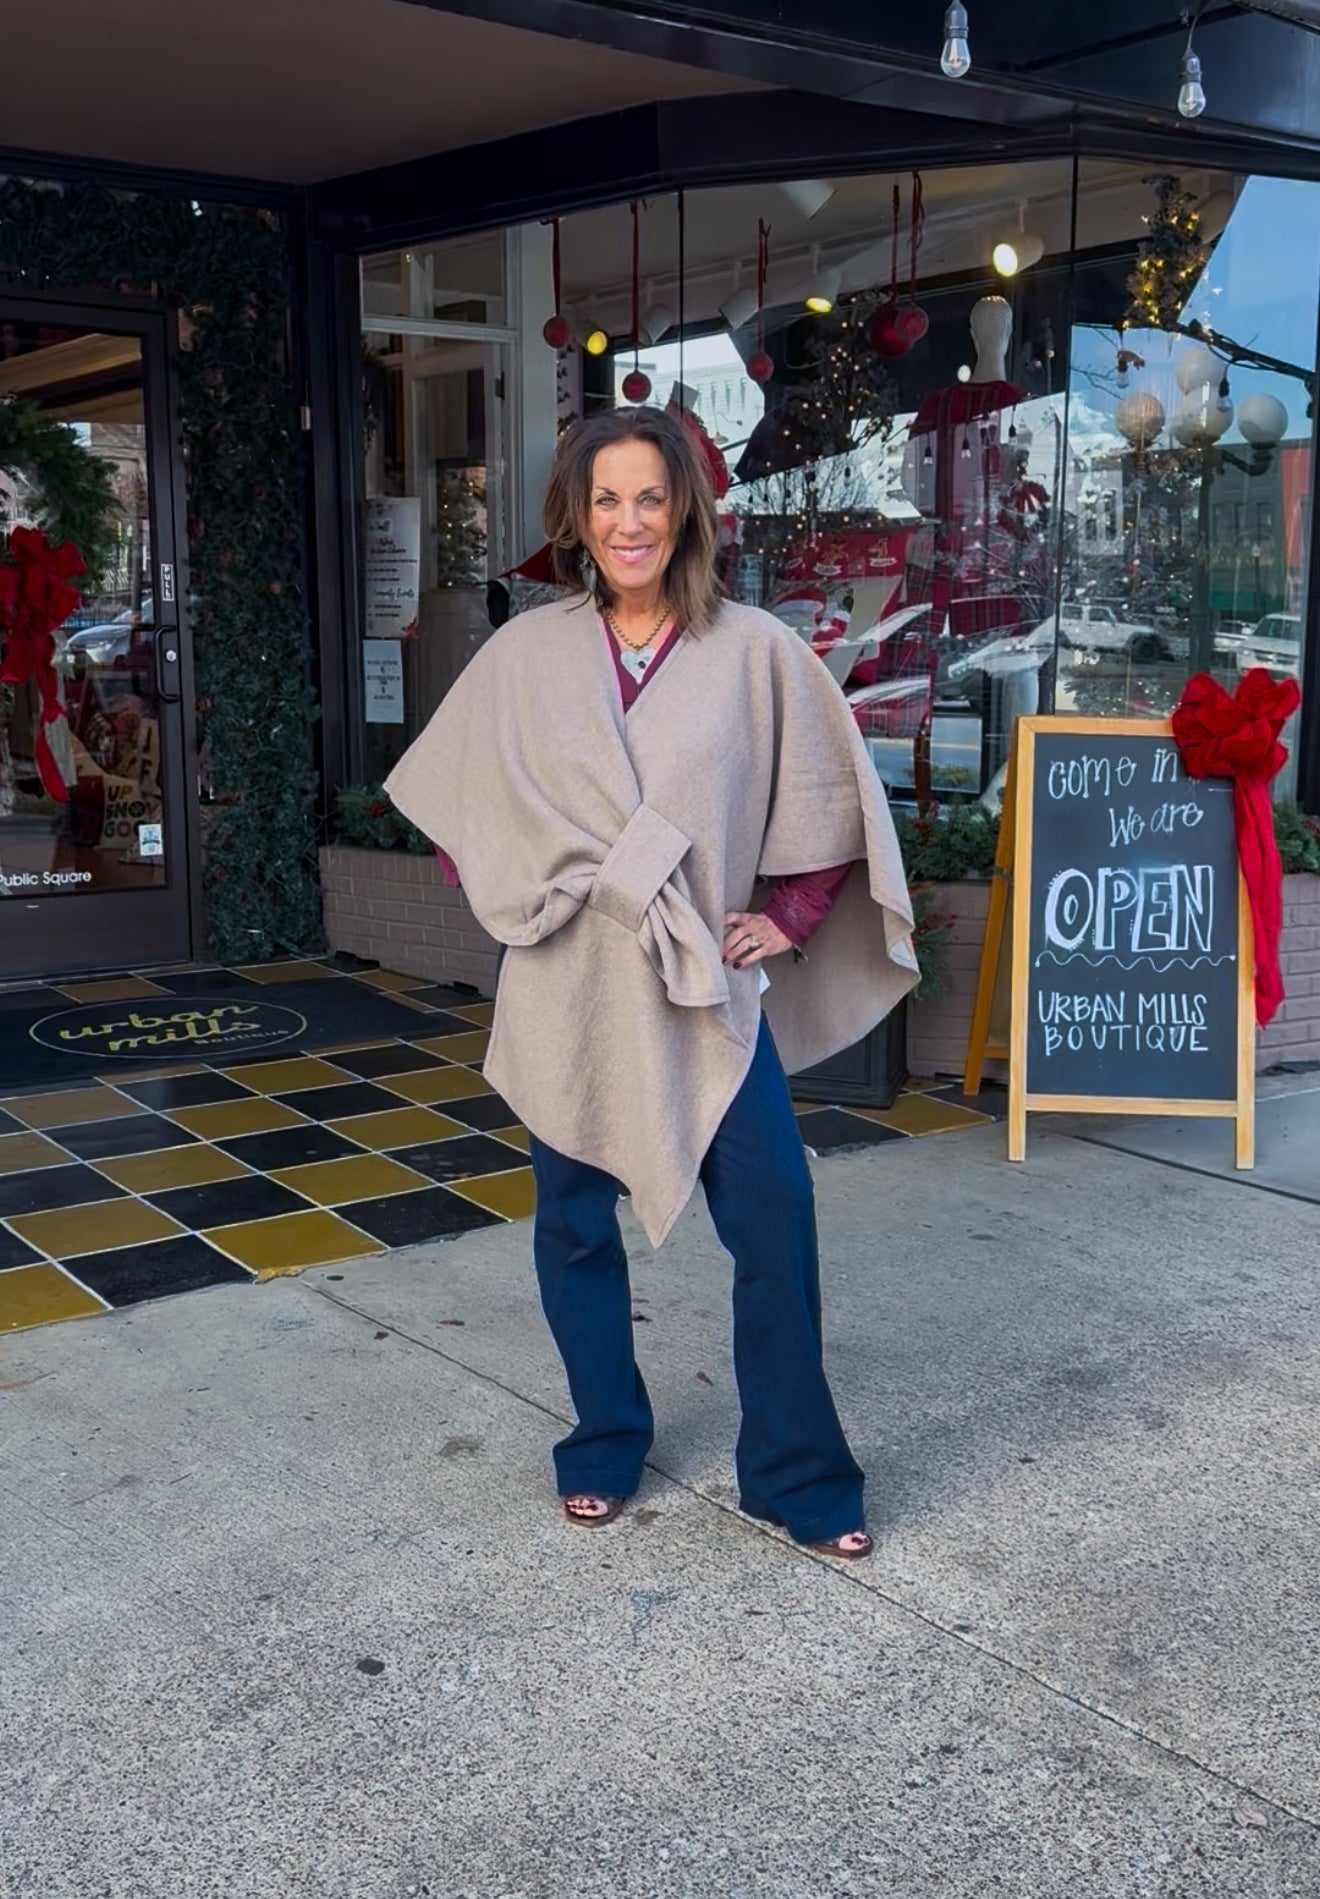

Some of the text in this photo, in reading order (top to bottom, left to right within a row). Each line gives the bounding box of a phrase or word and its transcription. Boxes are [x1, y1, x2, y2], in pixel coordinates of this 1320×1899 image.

[1150, 802, 1204, 833] are
[43, 871, 92, 886] Square
[1045, 864, 1214, 951] OPEN
[59, 1005, 259, 1040] urban
[1038, 990, 1207, 1026] URBAN MILLS
[108, 1017, 262, 1051] mills
[1045, 1024, 1208, 1057] BOUTIQUE
